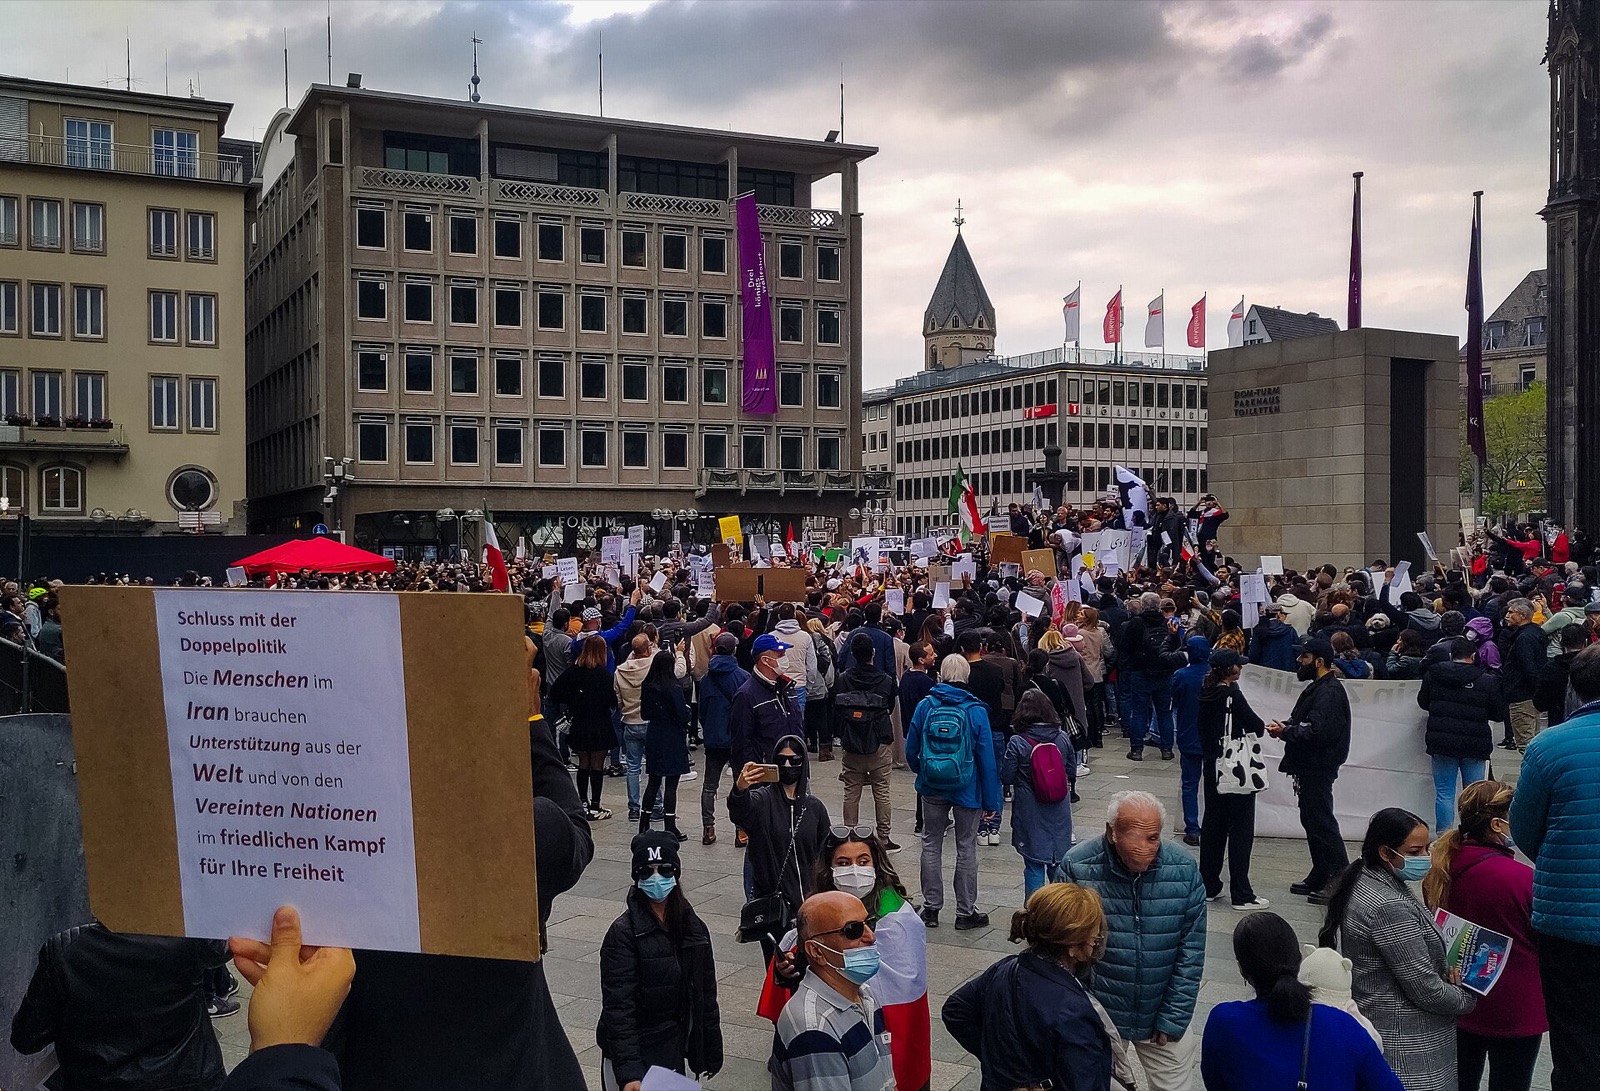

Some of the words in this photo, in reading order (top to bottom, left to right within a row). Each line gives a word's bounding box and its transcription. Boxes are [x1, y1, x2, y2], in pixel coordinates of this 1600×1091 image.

[1234, 387, 1280, 399] DOM-TURM
[1234, 396, 1280, 408] PARKHAUS
[1234, 405, 1280, 417] TOILETTEN
[558, 516, 617, 528] FORUM
[177, 610, 236, 628] Schluss
[239, 612, 267, 628] mit
[270, 612, 298, 629] der
[180, 637, 288, 657] Doppelpolitik
[183, 670, 209, 686] Die
[213, 669, 310, 690] Menschen
[313, 674, 334, 690] im
[186, 701, 230, 722] Iran
[234, 706, 308, 725] brauchen
[189, 734, 302, 757] Unterstützung
[305, 742, 333, 755] aus
[335, 739, 362, 757] der
[192, 762, 244, 785] Welt
[248, 770, 278, 786] und
[281, 774, 310, 788] von
[314, 772, 344, 789] den
[195, 796, 286, 819] Vereinten
[290, 801, 378, 823] Nationen
[197, 830, 217, 846] im
[219, 828, 320, 852] friedlichen
[324, 834, 387, 857] Kampf
[647, 846, 662, 861] M
[199, 857, 227, 876] für
[231, 857, 269, 879] Ihre
[273, 862, 346, 883] Freiheit
